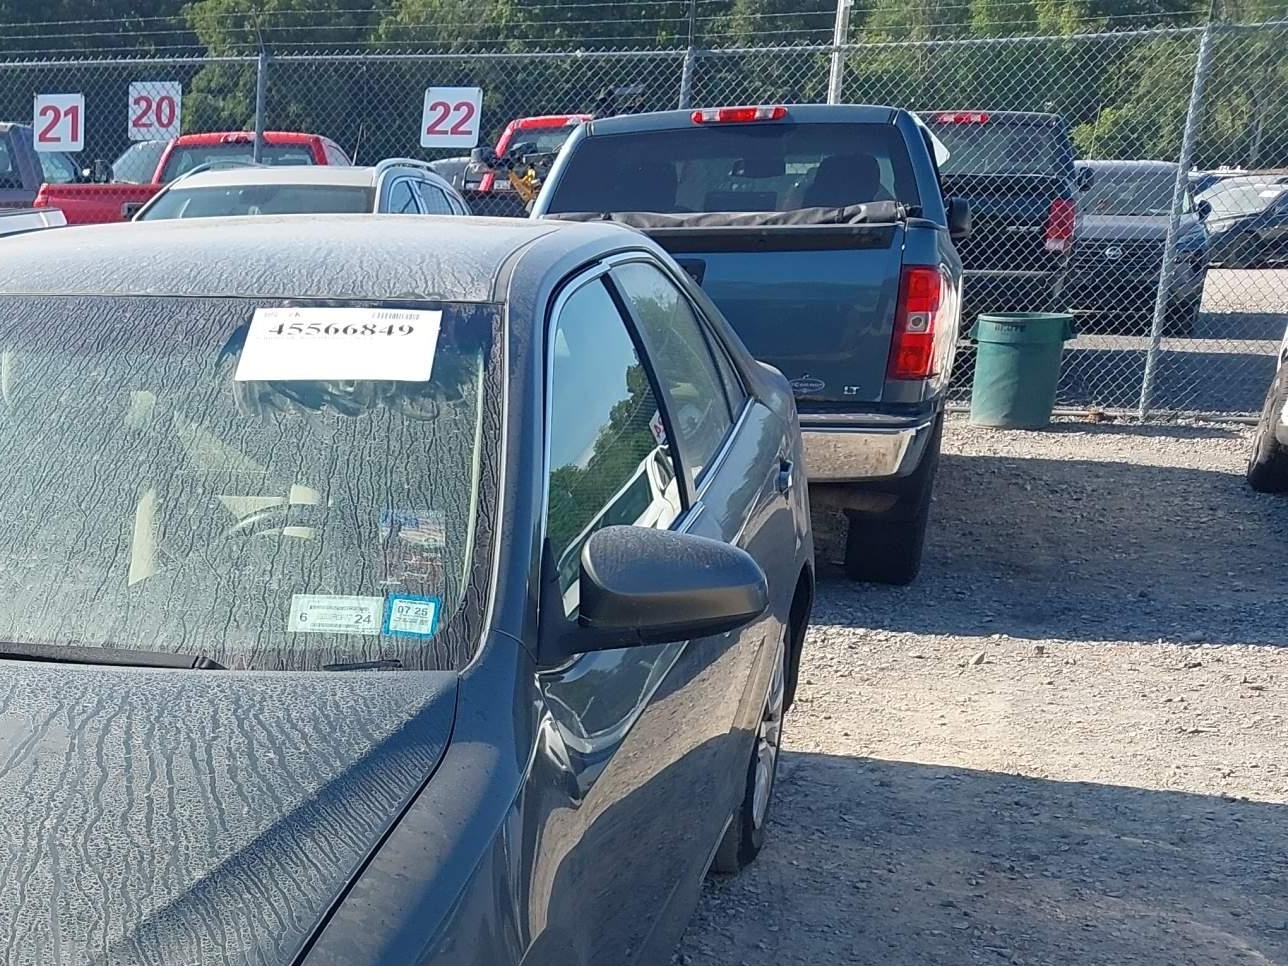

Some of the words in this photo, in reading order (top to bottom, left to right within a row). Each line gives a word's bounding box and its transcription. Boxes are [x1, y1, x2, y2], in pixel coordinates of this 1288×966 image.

[133, 96, 176, 128] 20
[426, 101, 475, 136] 22
[38, 105, 79, 143] 21
[268, 322, 415, 337] 45566849
[843, 386, 861, 395] LT
[354, 614, 372, 625] 24
